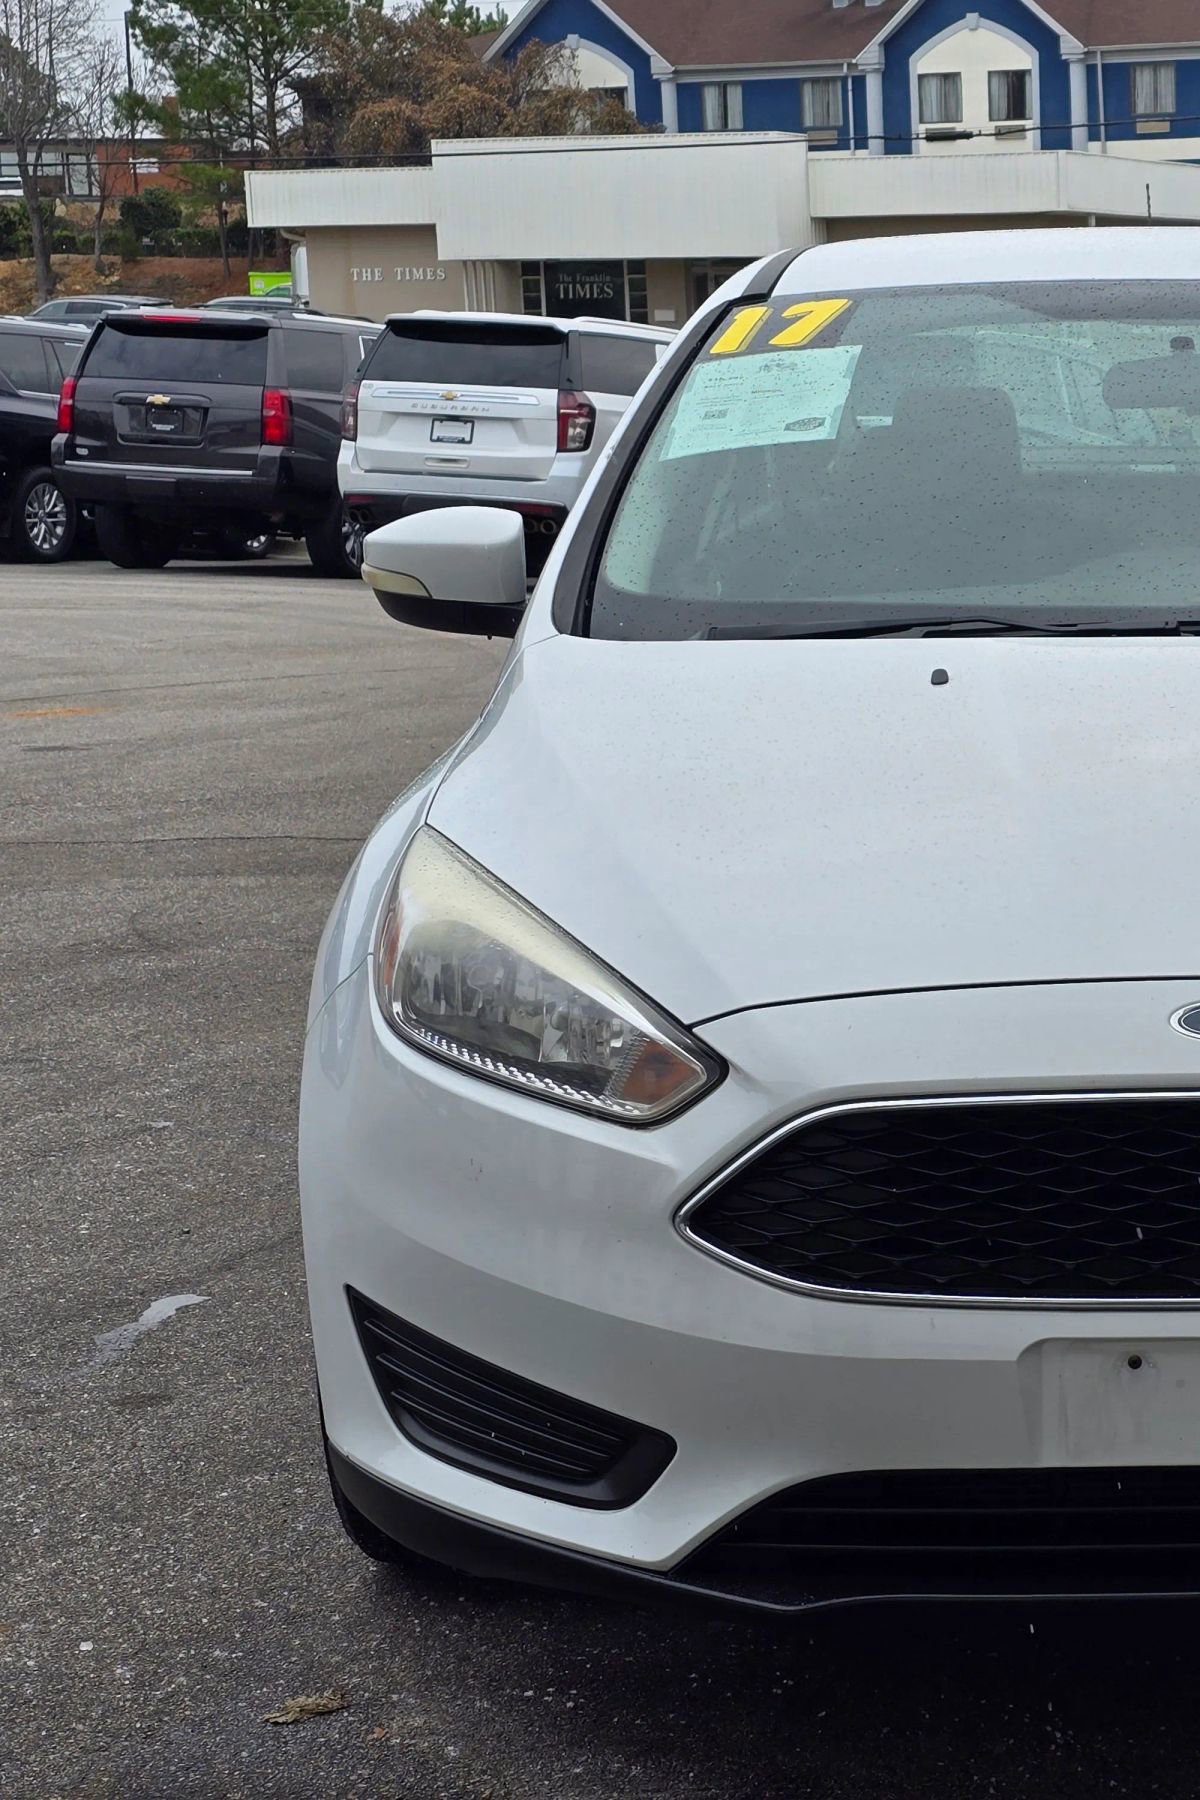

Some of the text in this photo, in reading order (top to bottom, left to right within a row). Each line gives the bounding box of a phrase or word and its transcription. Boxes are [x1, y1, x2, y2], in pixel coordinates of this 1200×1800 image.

[350, 267, 446, 281] THE TIMES
[555, 282, 614, 299] TIMES
[709, 298, 852, 354] 17
